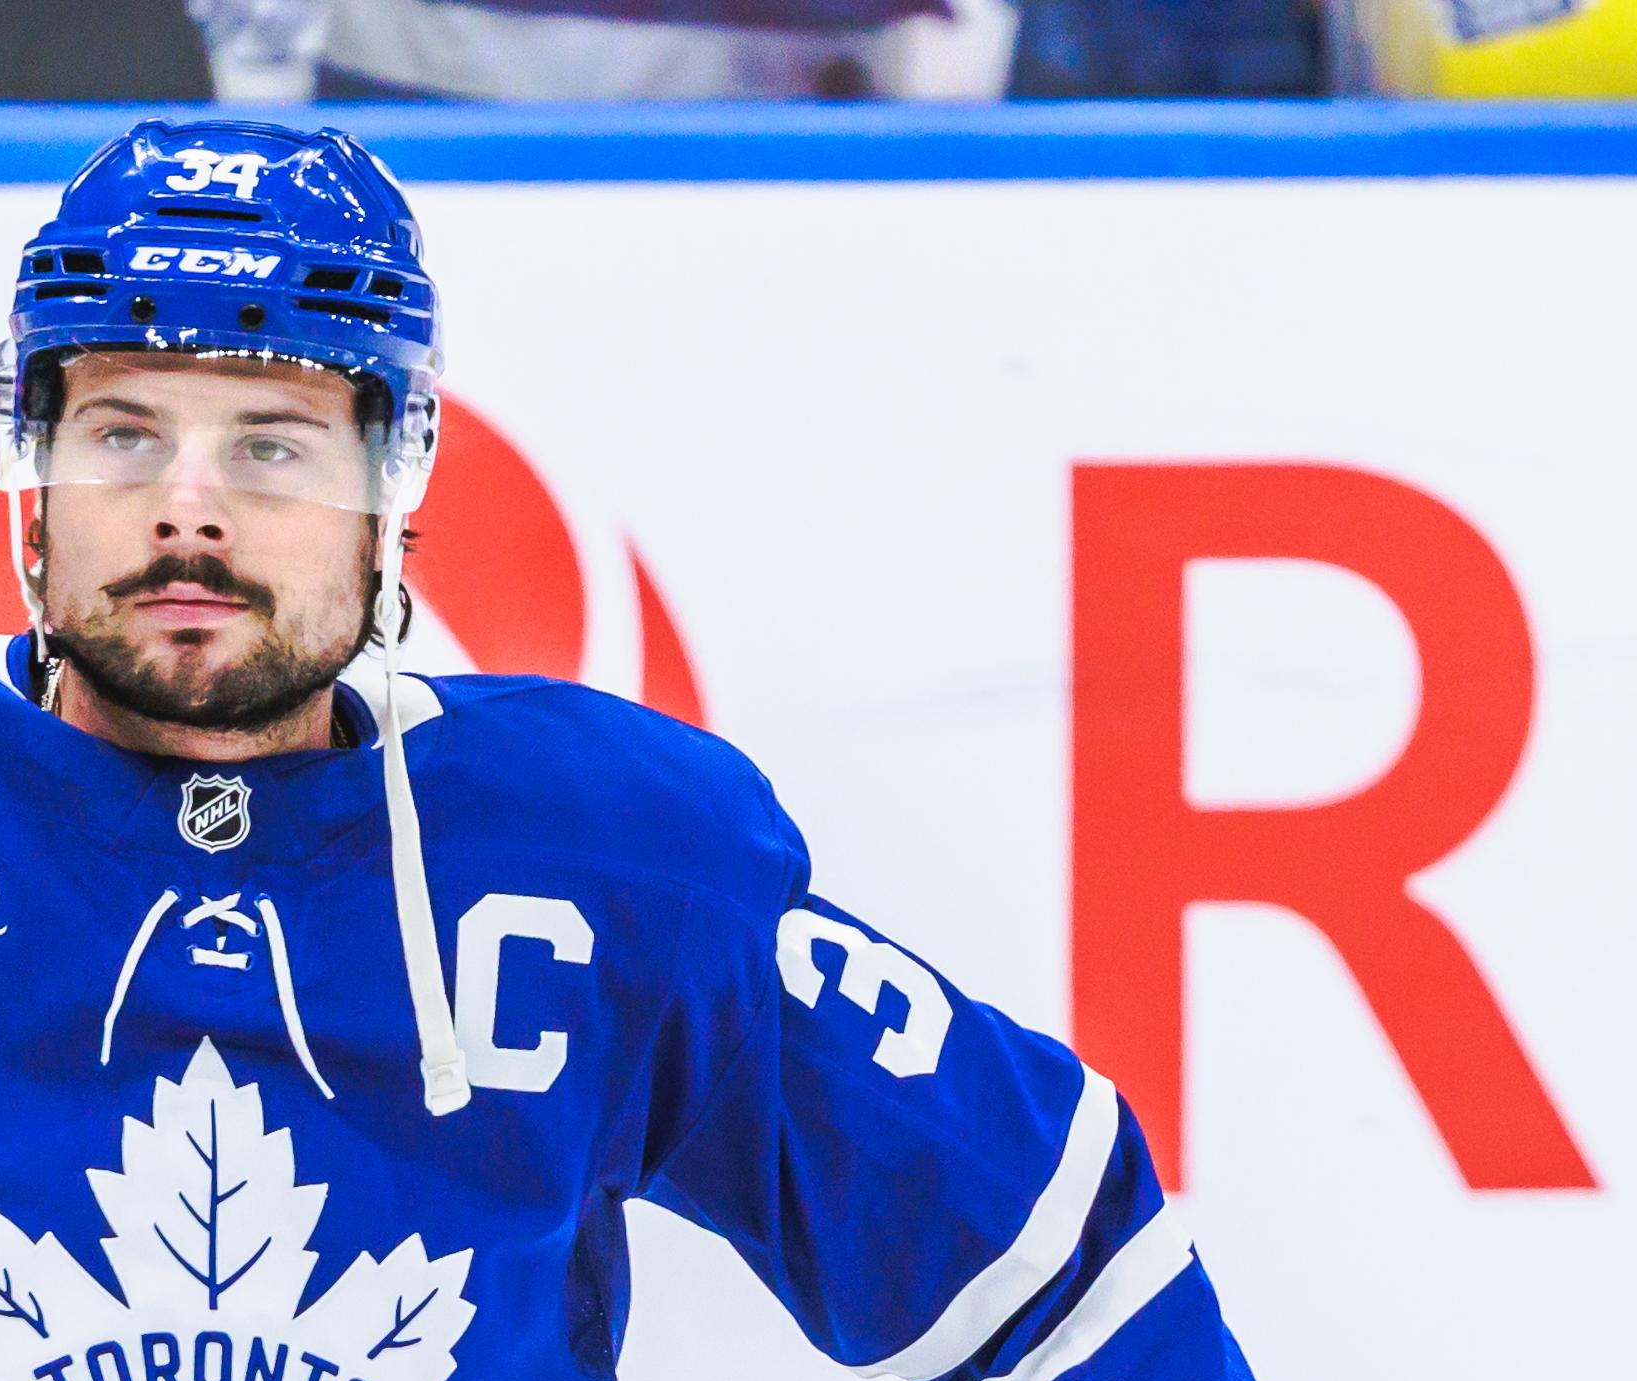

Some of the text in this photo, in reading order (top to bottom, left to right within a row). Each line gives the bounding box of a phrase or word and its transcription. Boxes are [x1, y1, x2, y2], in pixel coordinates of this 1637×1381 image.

[166, 149, 267, 199] 34
[127, 246, 282, 279] CCM
[194, 795, 237, 834] NHL
[455, 893, 596, 1092] C
